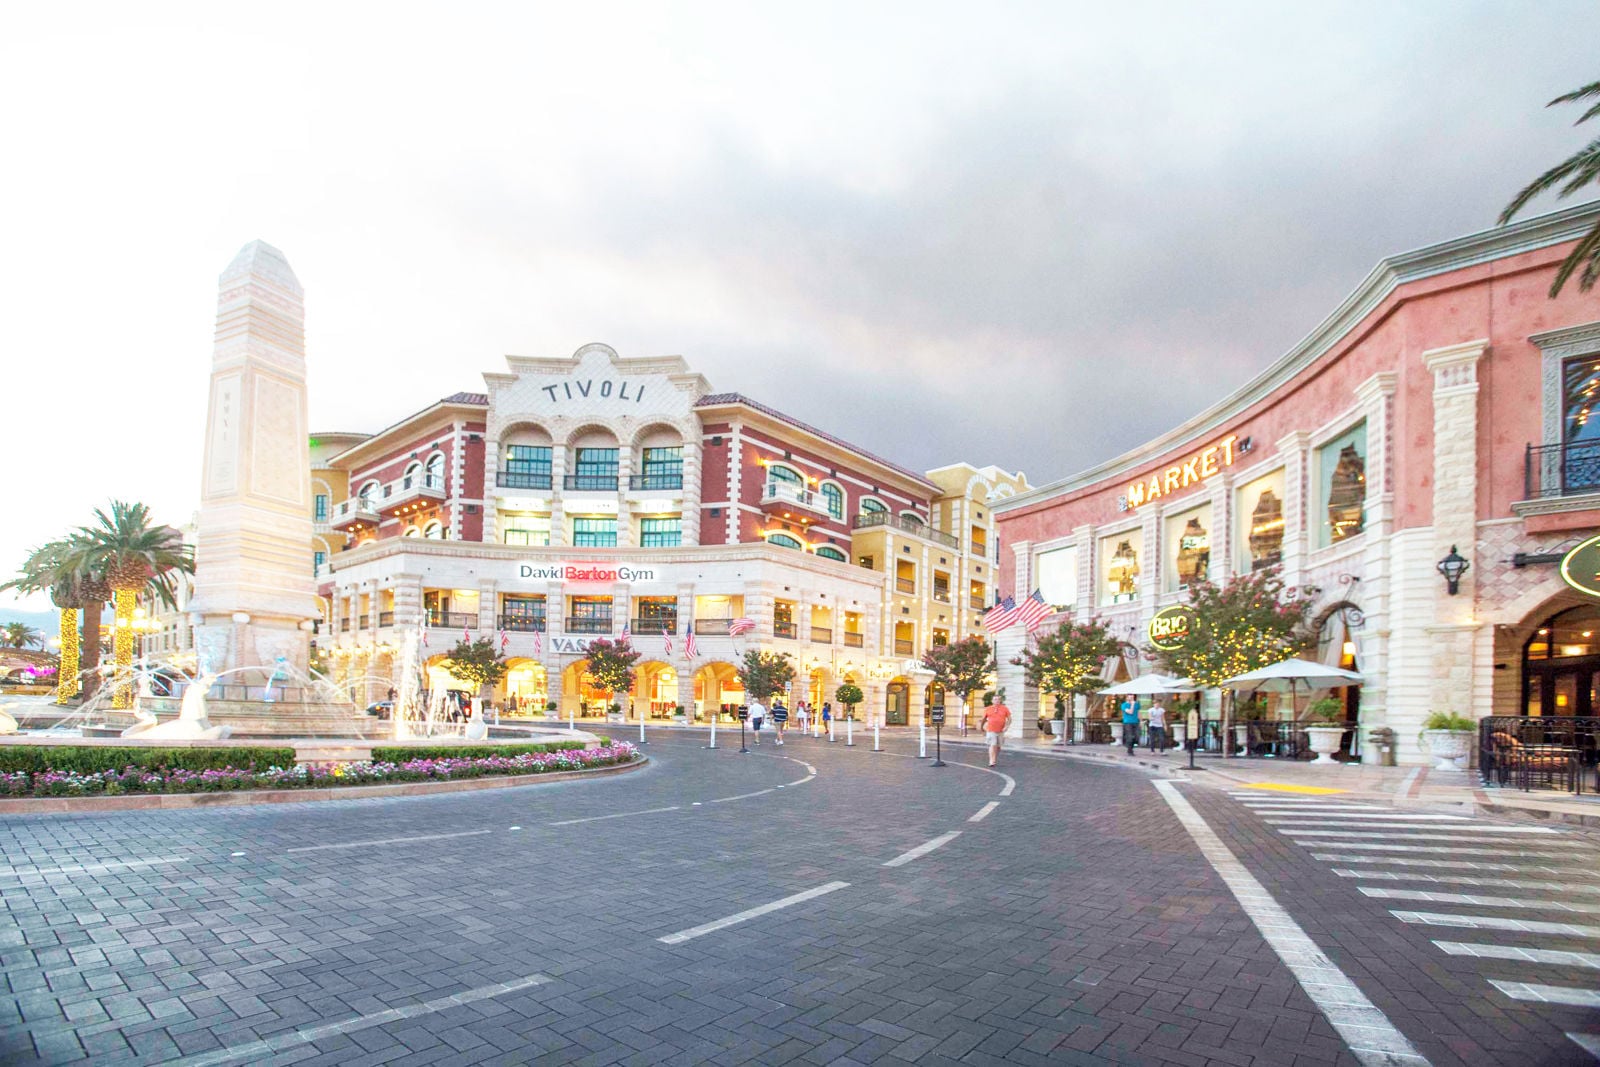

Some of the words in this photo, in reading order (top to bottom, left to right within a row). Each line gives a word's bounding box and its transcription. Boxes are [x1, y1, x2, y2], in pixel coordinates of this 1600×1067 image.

[542, 380, 645, 402] TIVOLI
[1127, 435, 1238, 508] MARKET
[551, 638, 588, 653] VAS
